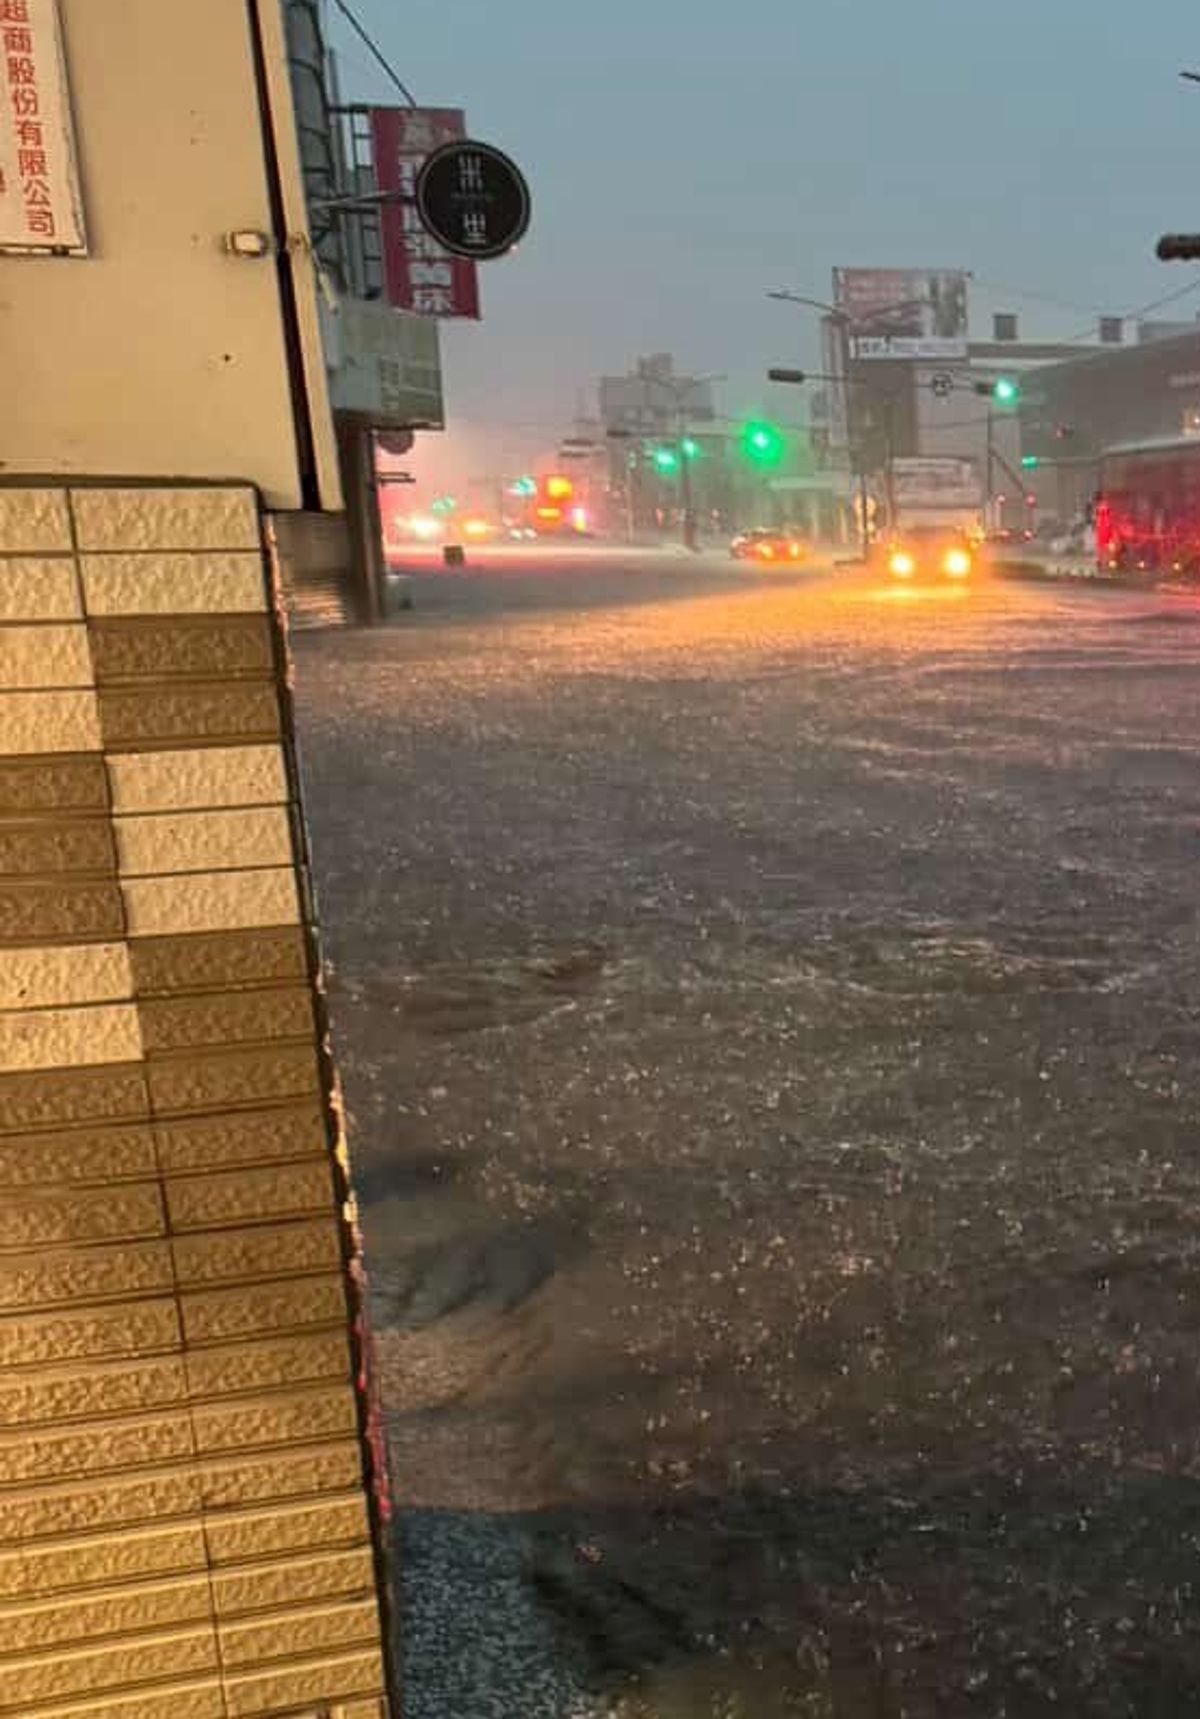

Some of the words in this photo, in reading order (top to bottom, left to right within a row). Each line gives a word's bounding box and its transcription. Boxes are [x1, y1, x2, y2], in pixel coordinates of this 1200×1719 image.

[0, 0, 55, 237] 超商股份有限公司
